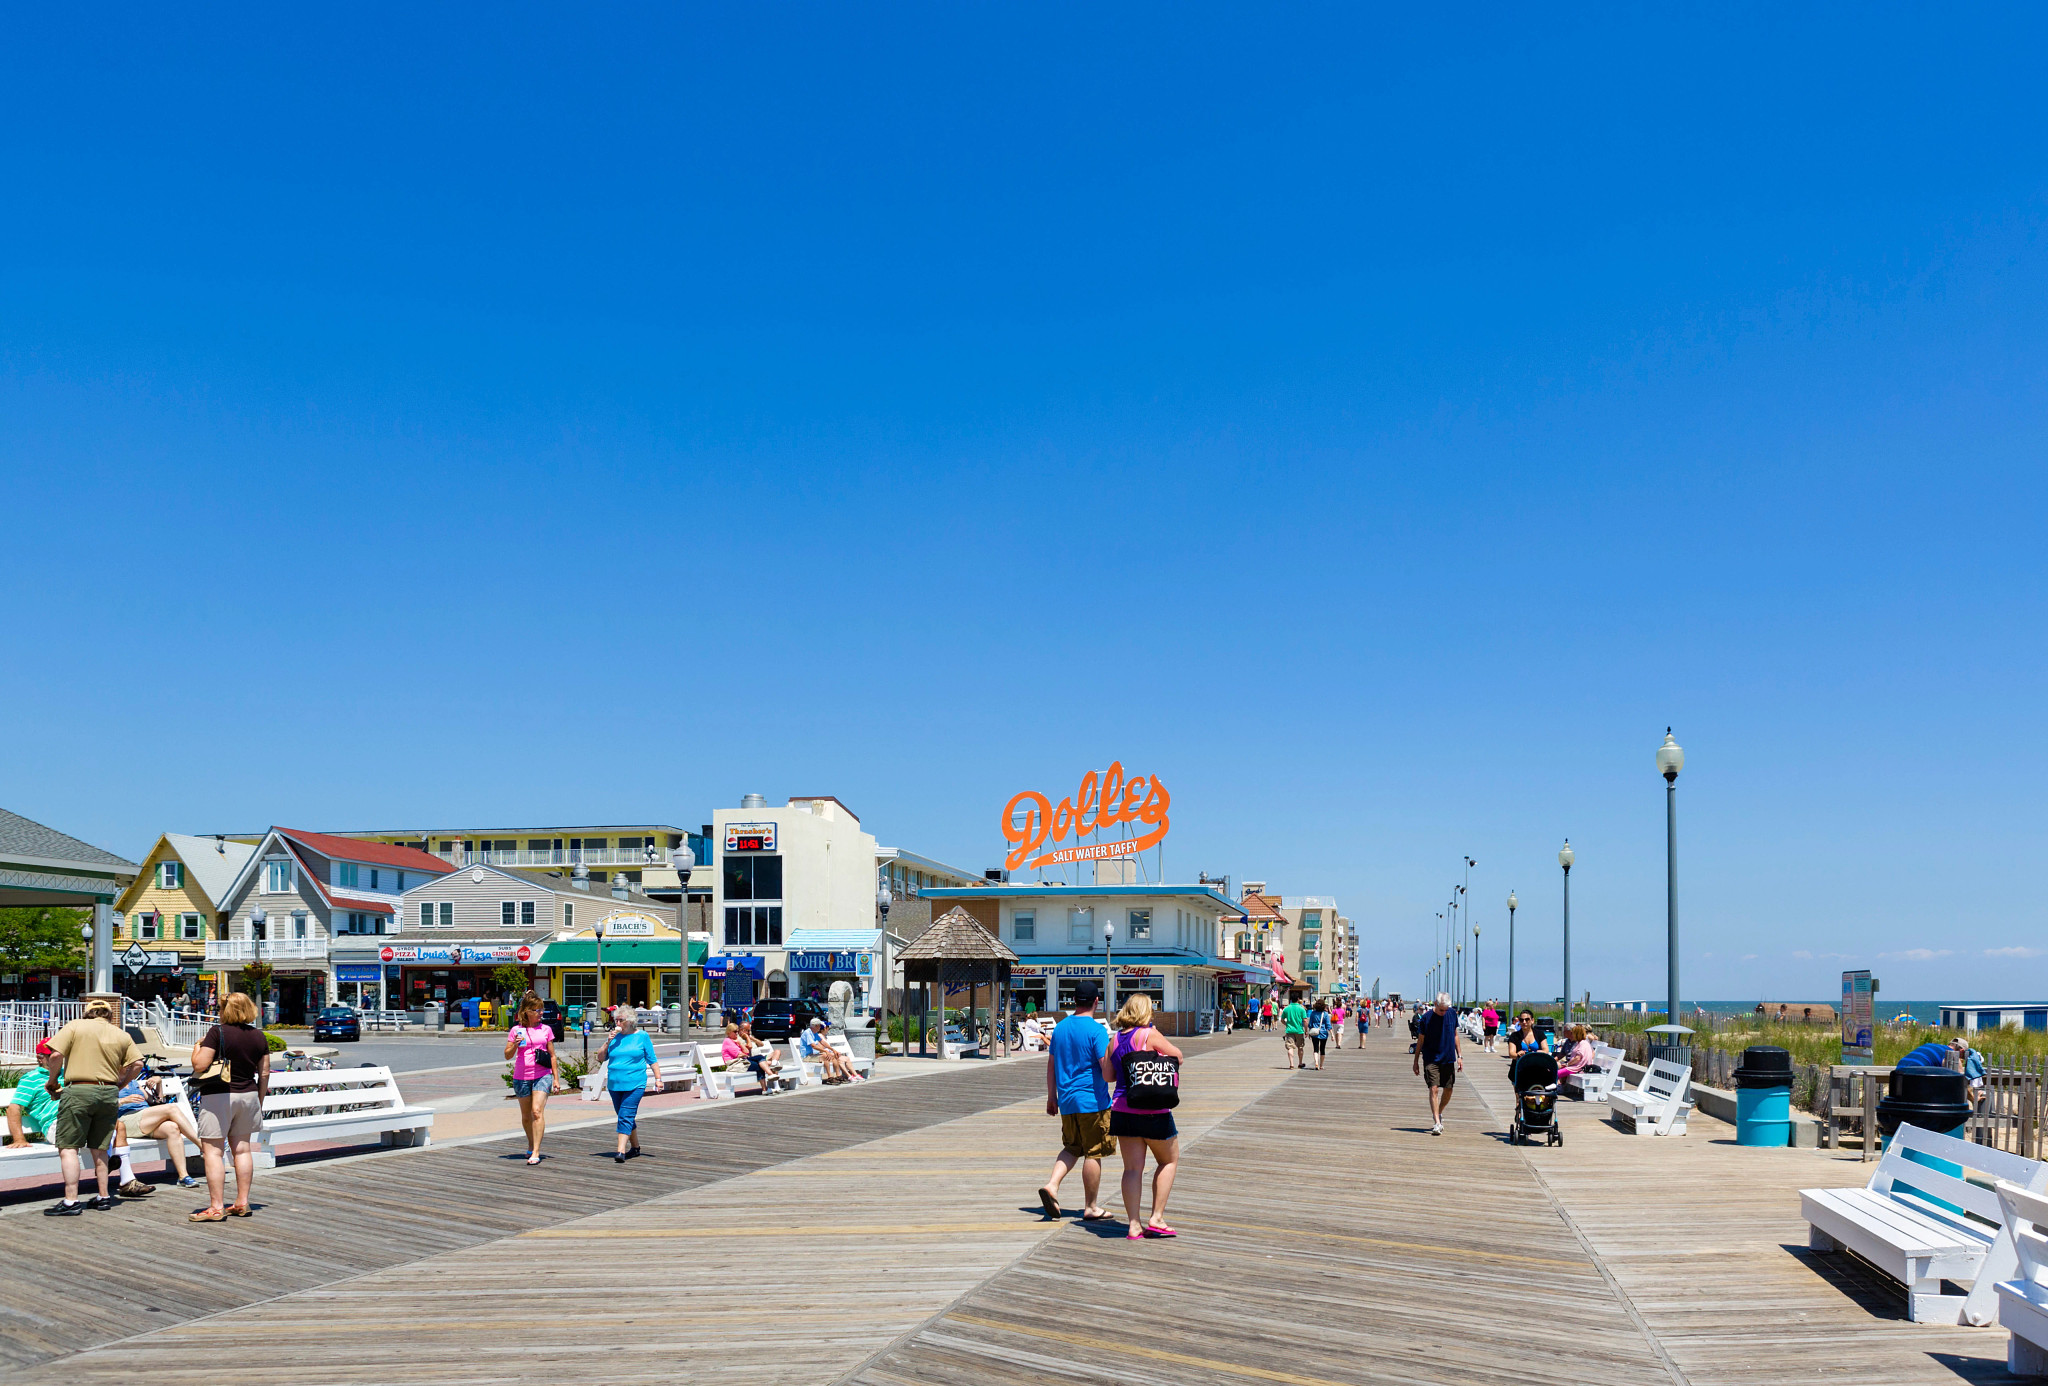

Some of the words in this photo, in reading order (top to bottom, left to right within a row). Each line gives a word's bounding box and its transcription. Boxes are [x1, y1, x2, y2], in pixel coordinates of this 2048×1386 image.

[729, 827, 773, 835] Thrasher's
[1052, 850, 1073, 863] SALT
[1076, 844, 1107, 860] WATER
[1109, 840, 1138, 856] TAFFY
[417, 947, 449, 961] Louie's
[462, 948, 493, 962] Pizza
[791, 955, 828, 969] KOHR
[1010, 967, 1037, 976] udge
[1042, 967, 1063, 975] POP
[1066, 967, 1095, 975] CORN
[1121, 965, 1152, 978] Taffy
[1128, 1061, 1176, 1074] VICTORIA'S
[1129, 1071, 1176, 1089] SECRET
